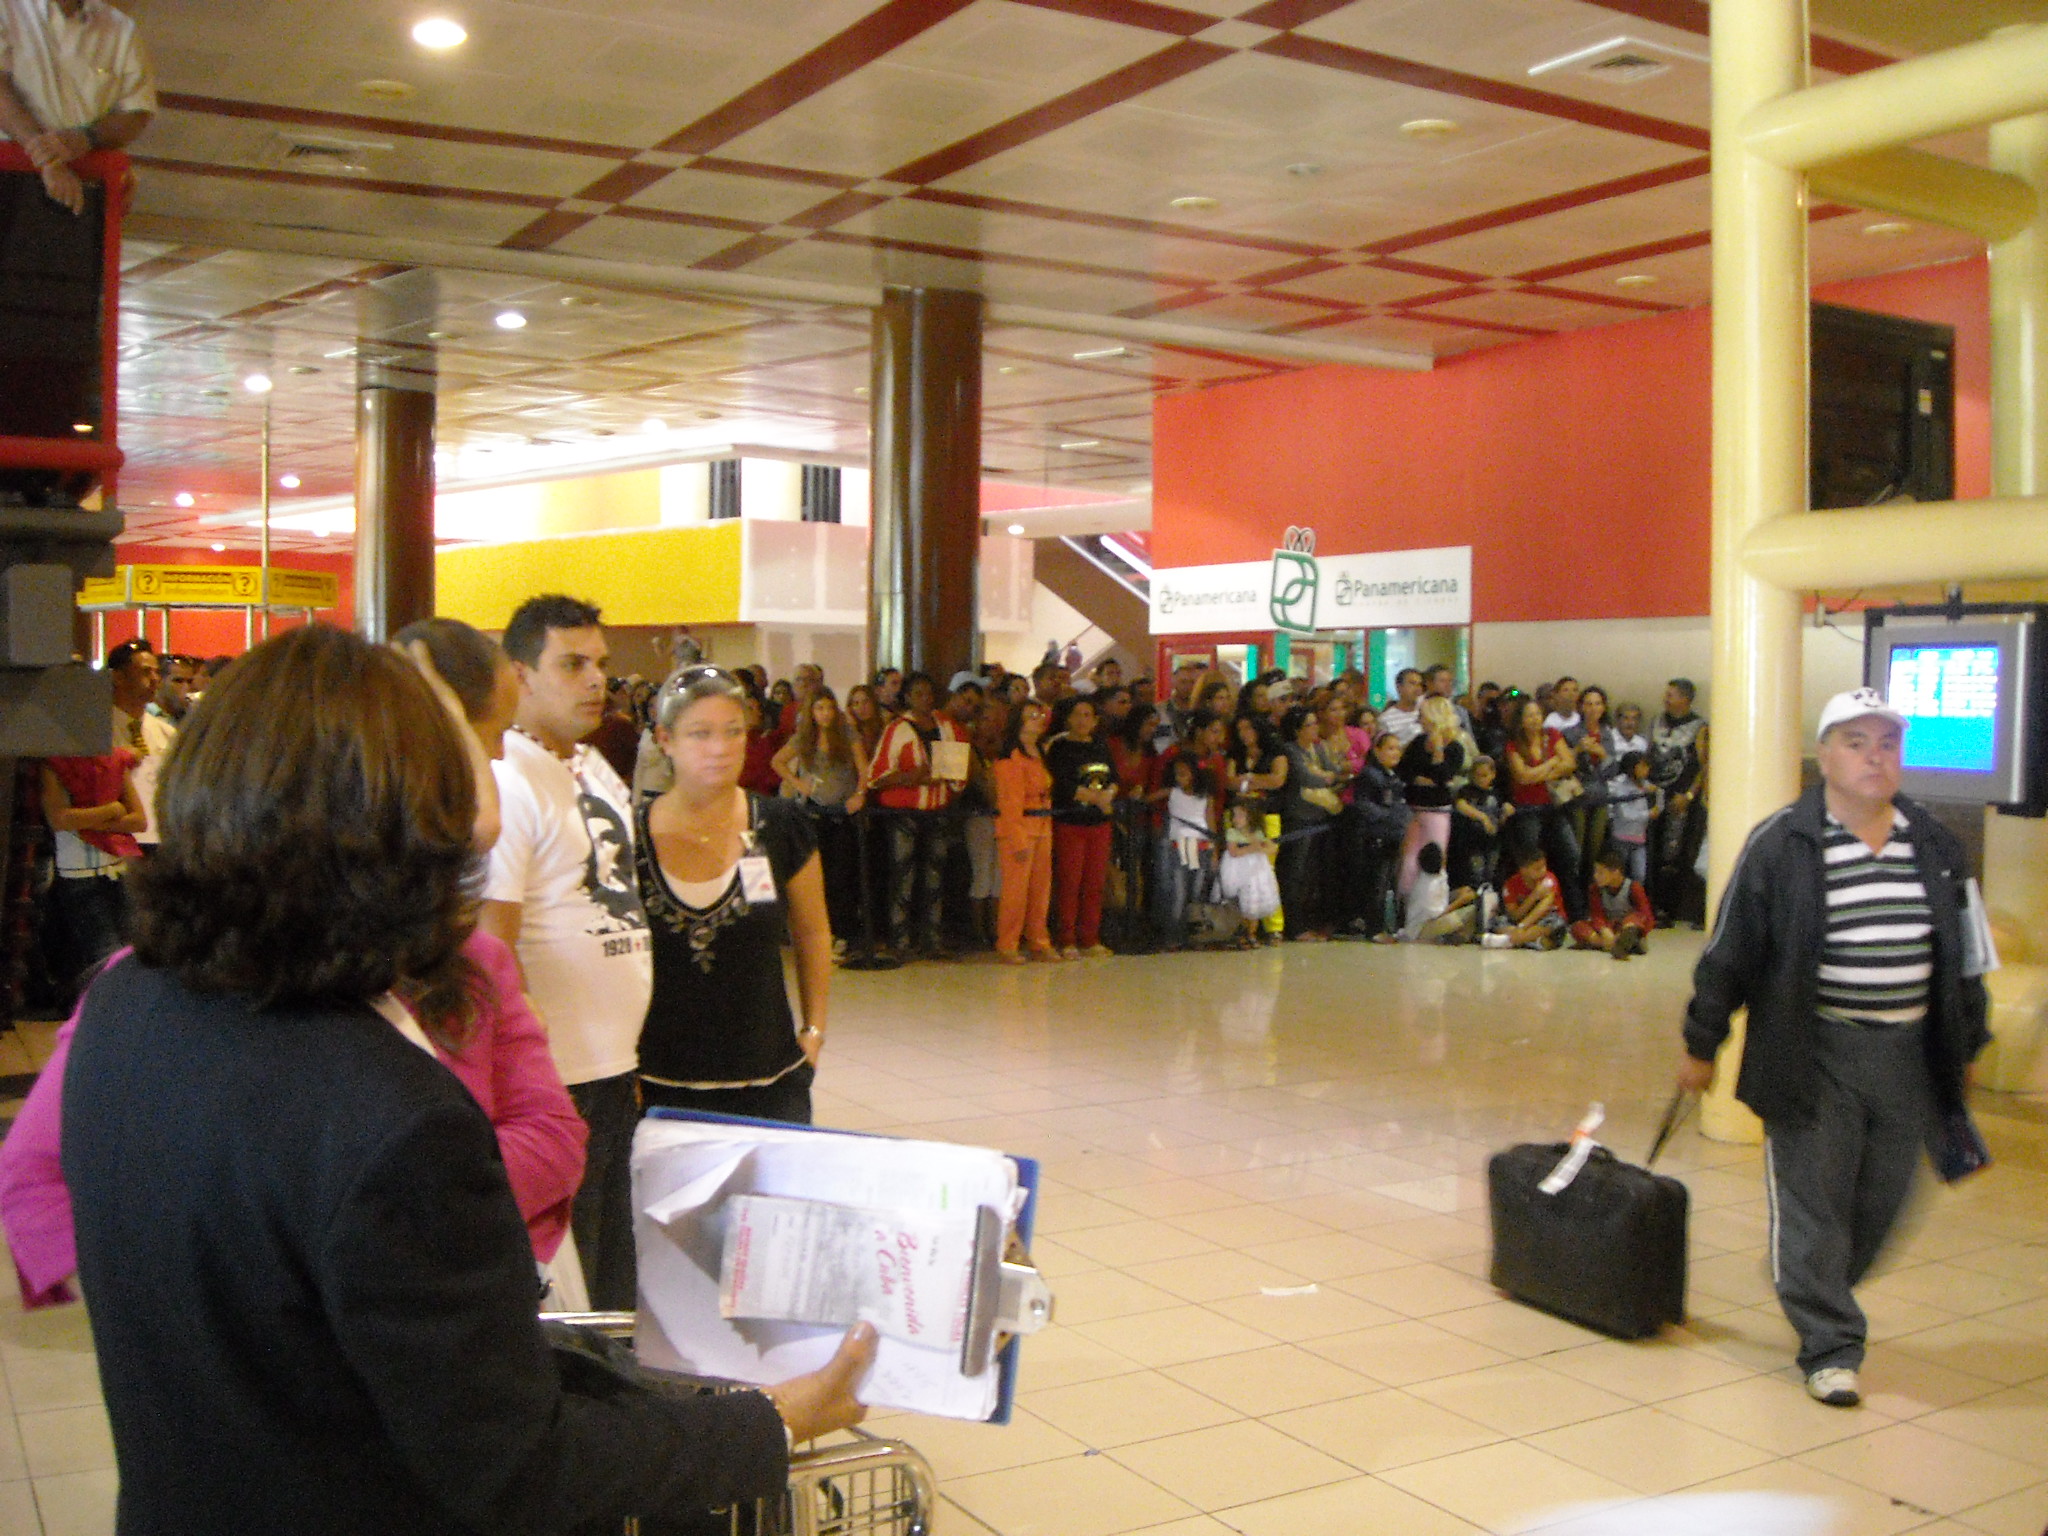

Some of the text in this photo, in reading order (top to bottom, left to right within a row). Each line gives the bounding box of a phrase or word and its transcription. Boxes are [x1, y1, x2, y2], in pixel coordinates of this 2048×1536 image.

[1174, 586, 1258, 607] Panamericana
[1354, 575, 1459, 598] Panamericana
[876, 1249, 897, 1295] Cuba
